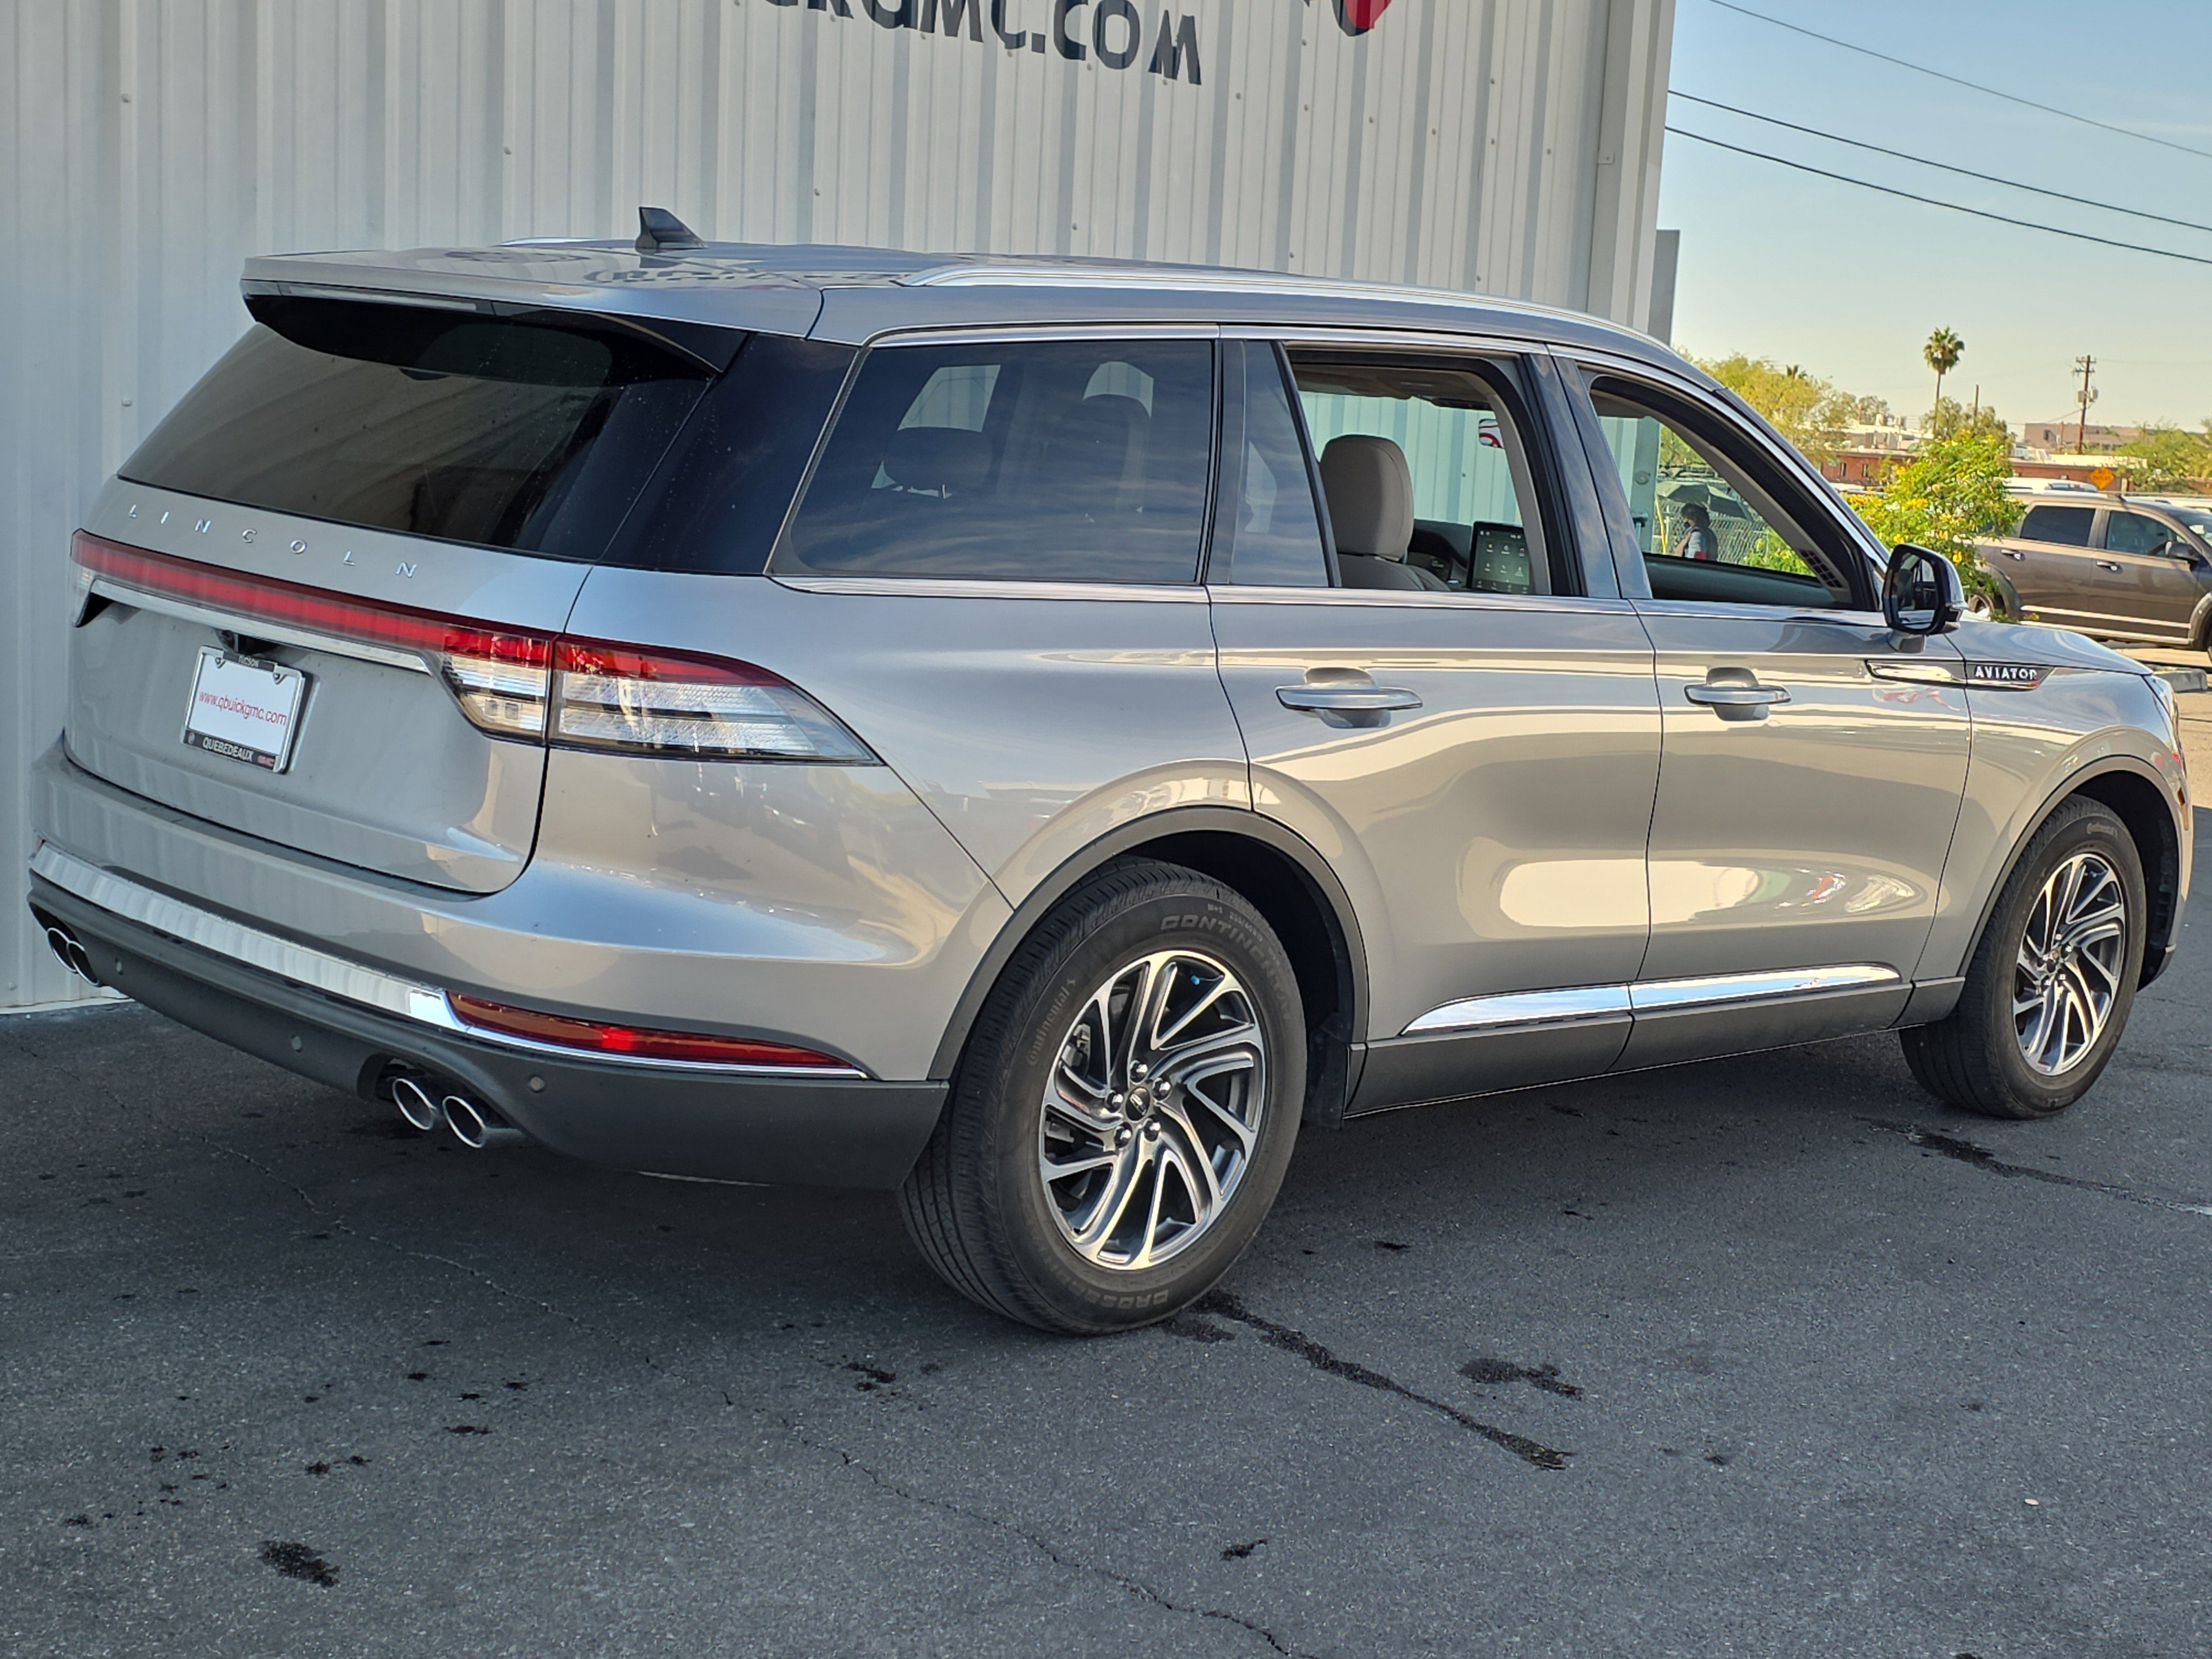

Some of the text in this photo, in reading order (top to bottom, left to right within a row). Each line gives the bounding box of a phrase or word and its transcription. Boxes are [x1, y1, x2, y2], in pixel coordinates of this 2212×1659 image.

[766, 0, 1202, 85] MC.COM
[128, 504, 417, 578] LINCOLN
[1975, 666, 2037, 680] AVIATOR
[198, 691, 287, 726] www.qbuickgmc.com
[202, 736, 254, 762] QUEBEDEAUX
